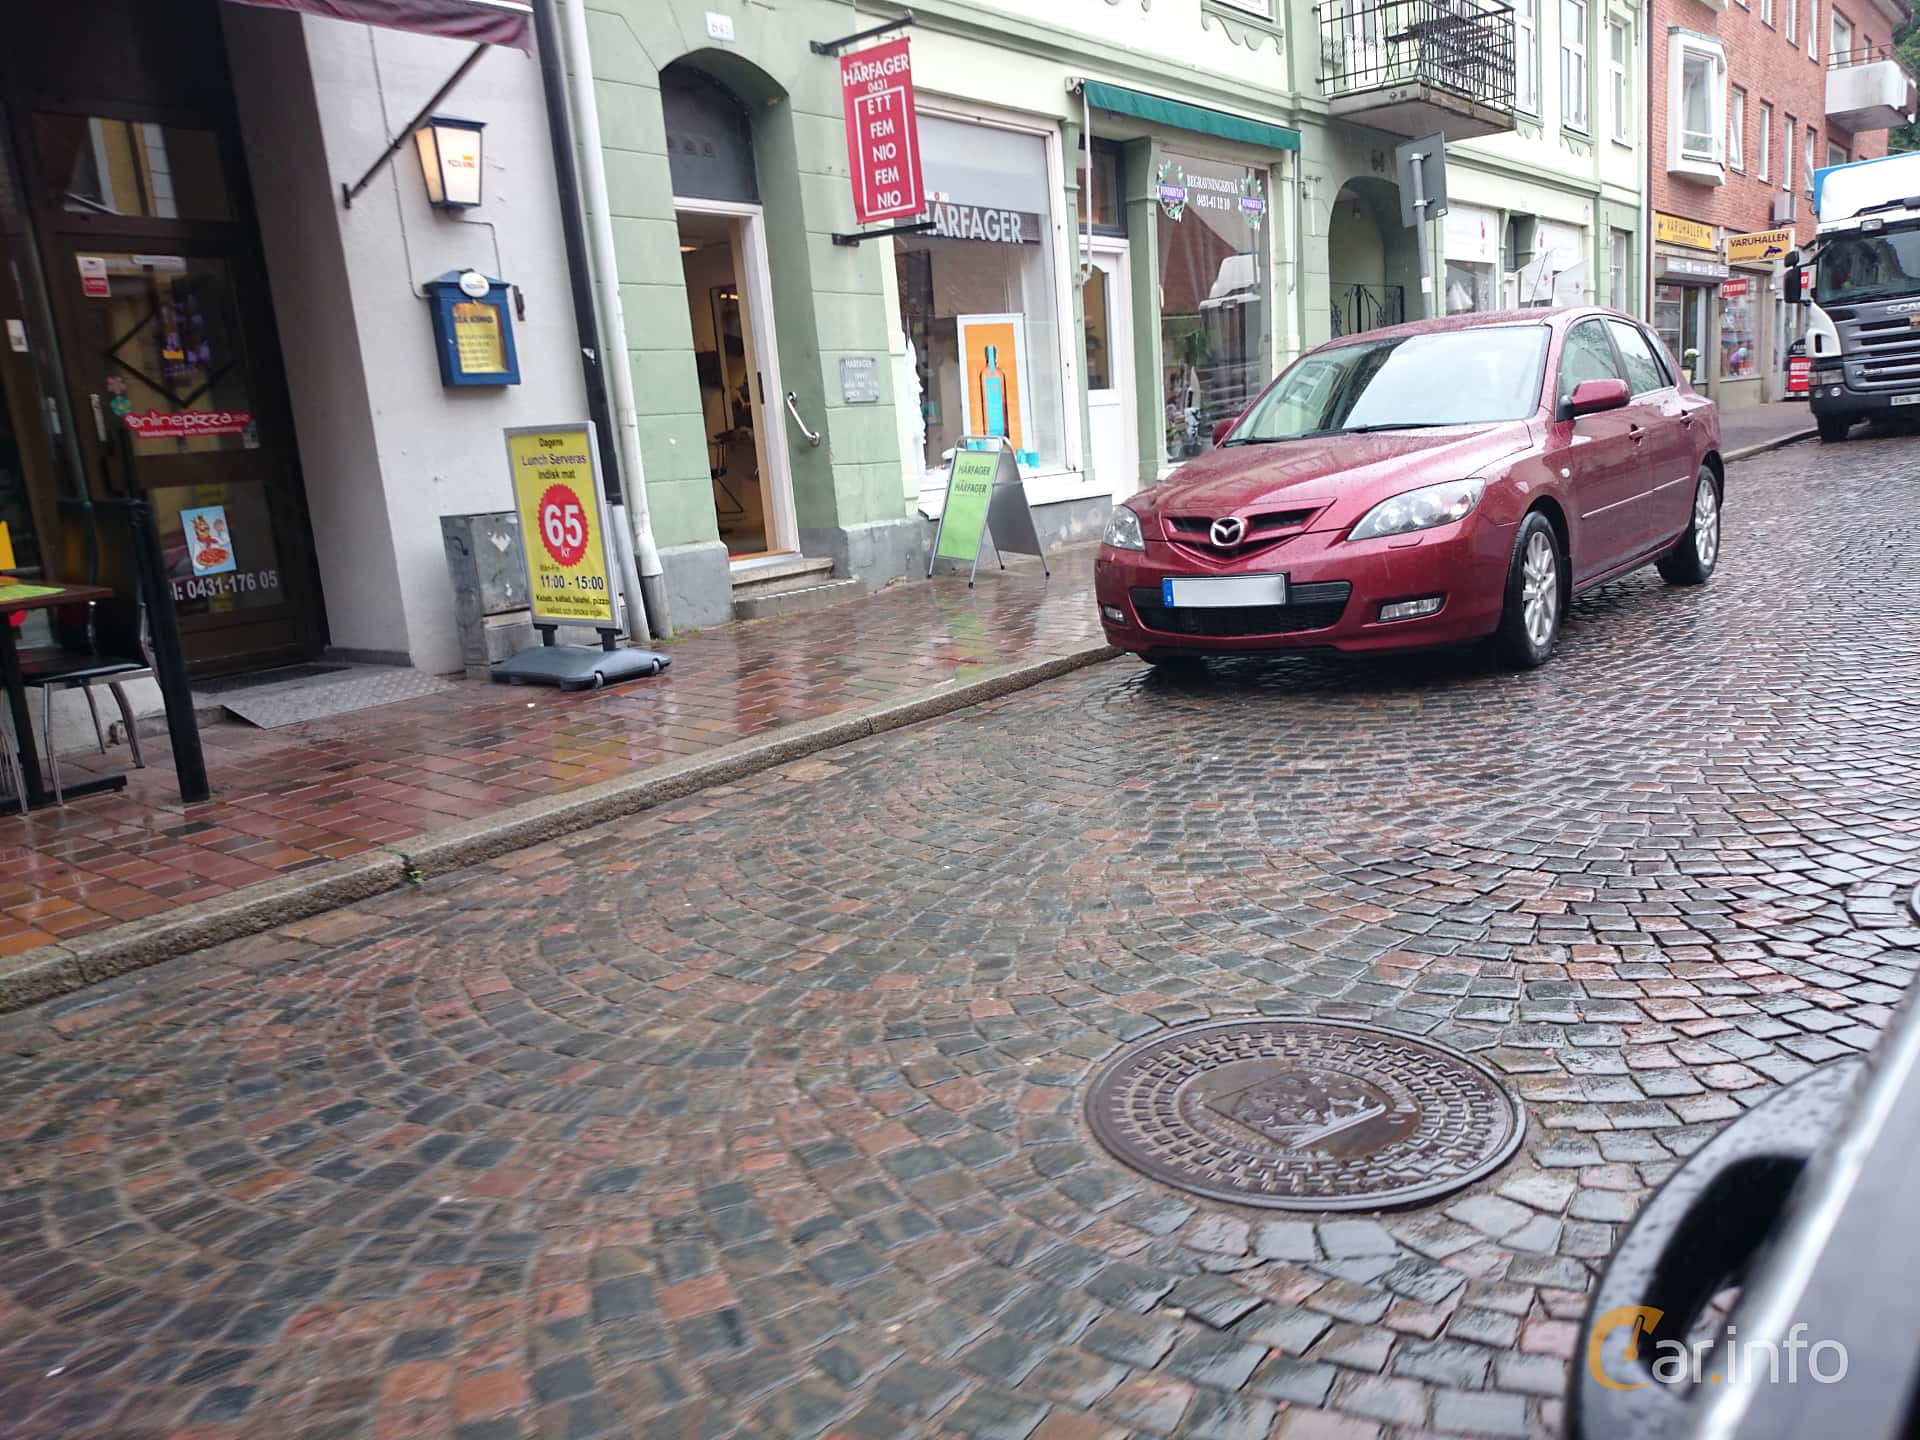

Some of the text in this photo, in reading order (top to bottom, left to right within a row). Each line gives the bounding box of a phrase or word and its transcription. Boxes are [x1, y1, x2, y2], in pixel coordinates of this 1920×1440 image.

[868, 79, 888, 93] 0431
[867, 95, 891, 115] ETT
[870, 118, 895, 139] FEM
[872, 143, 897, 162] NIO
[875, 165, 899, 186] FEM
[877, 190, 901, 209] NIO
[1730, 232, 1789, 248] VARUHALLEN
[539, 438, 564, 449] Dagens
[522, 453, 586, 467] Lunch Serveras
[562, 469, 576, 479] mat
[544, 504, 583, 548] 65
[561, 547, 571, 558] kr
[260, 570, 279, 590] 05
[540, 575, 565, 589] 11:00
[575, 576, 604, 591] 15:00
